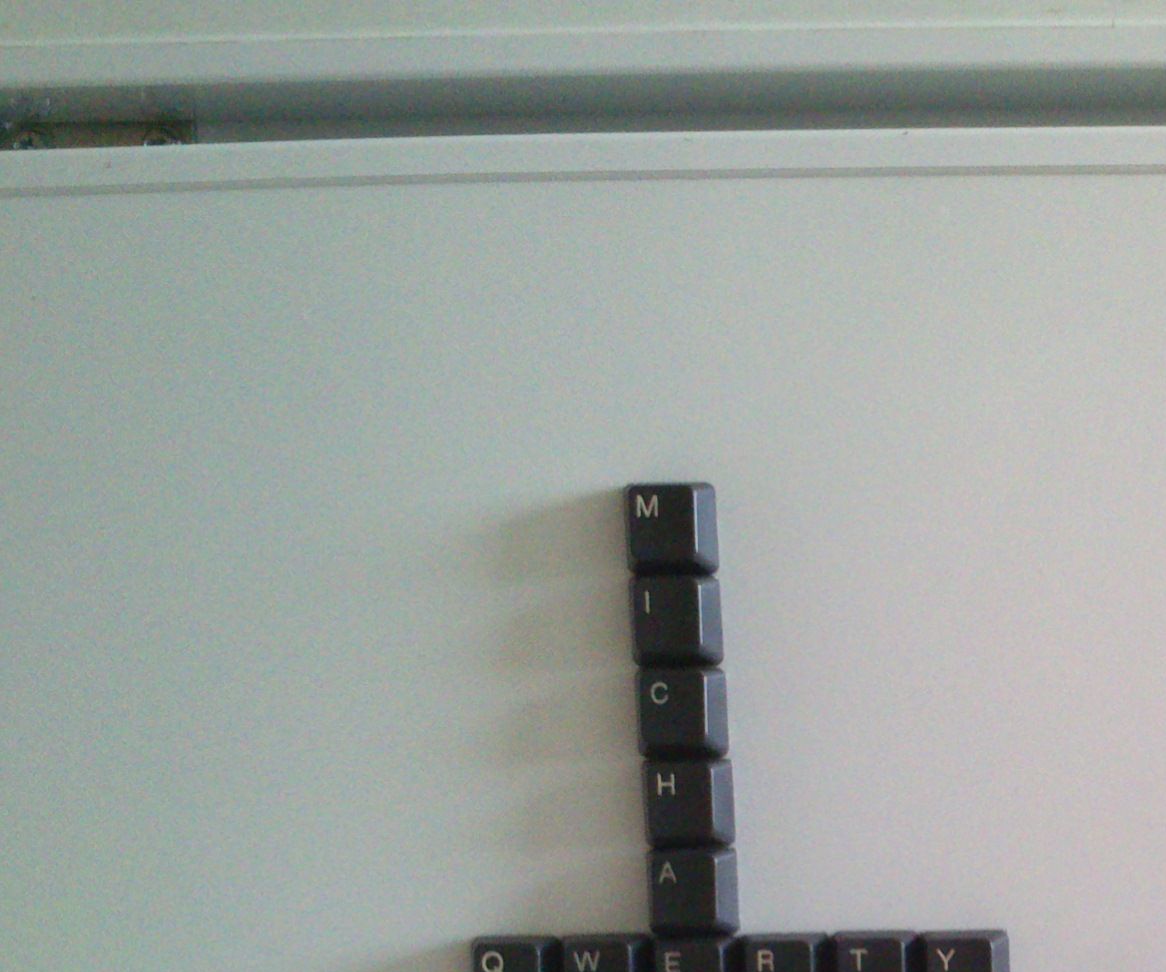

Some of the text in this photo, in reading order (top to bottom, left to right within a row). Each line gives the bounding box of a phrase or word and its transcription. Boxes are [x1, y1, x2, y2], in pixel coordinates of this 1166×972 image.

[635, 494, 659, 518] M
[644, 590, 651, 614] I
[649, 681, 669, 705] C
[656, 772, 676, 796] H
[658, 861, 677, 884] A
[573, 951, 600, 972] W
[756, 949, 774, 972] R
[849, 948, 868, 972] T
[936, 948, 955, 972] Y
